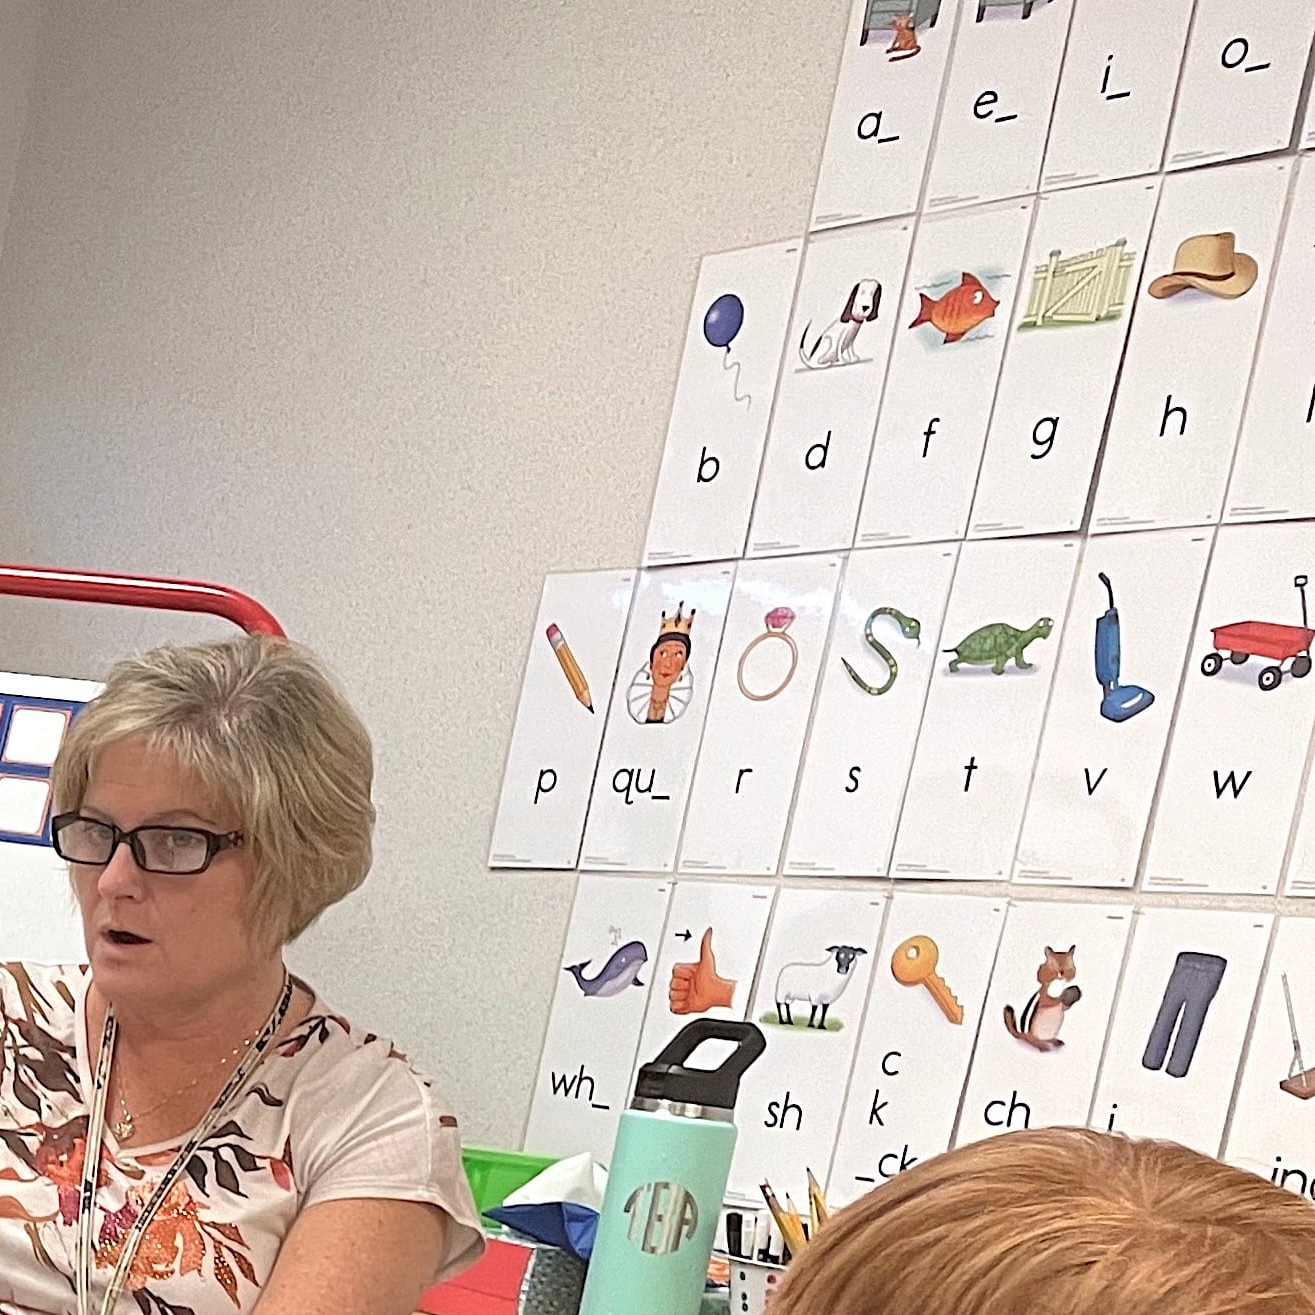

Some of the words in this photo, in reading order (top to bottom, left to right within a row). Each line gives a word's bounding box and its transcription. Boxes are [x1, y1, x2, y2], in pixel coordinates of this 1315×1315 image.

[1159, 394, 1188, 437] h
[805, 430, 832, 470] d
[922, 418, 940, 458] f
[1031, 413, 1059, 459] g
[697, 448, 720, 484] b
[534, 767, 557, 804] p
[735, 767, 754, 794] r
[845, 765, 862, 793] s
[963, 757, 978, 793] t
[1084, 767, 1108, 796] v
[1212, 770, 1253, 799] w
[881, 1051, 902, 1077] c
[764, 1091, 803, 1131] sh
[869, 1088, 889, 1127] k
[983, 1090, 1031, 1129] ch
